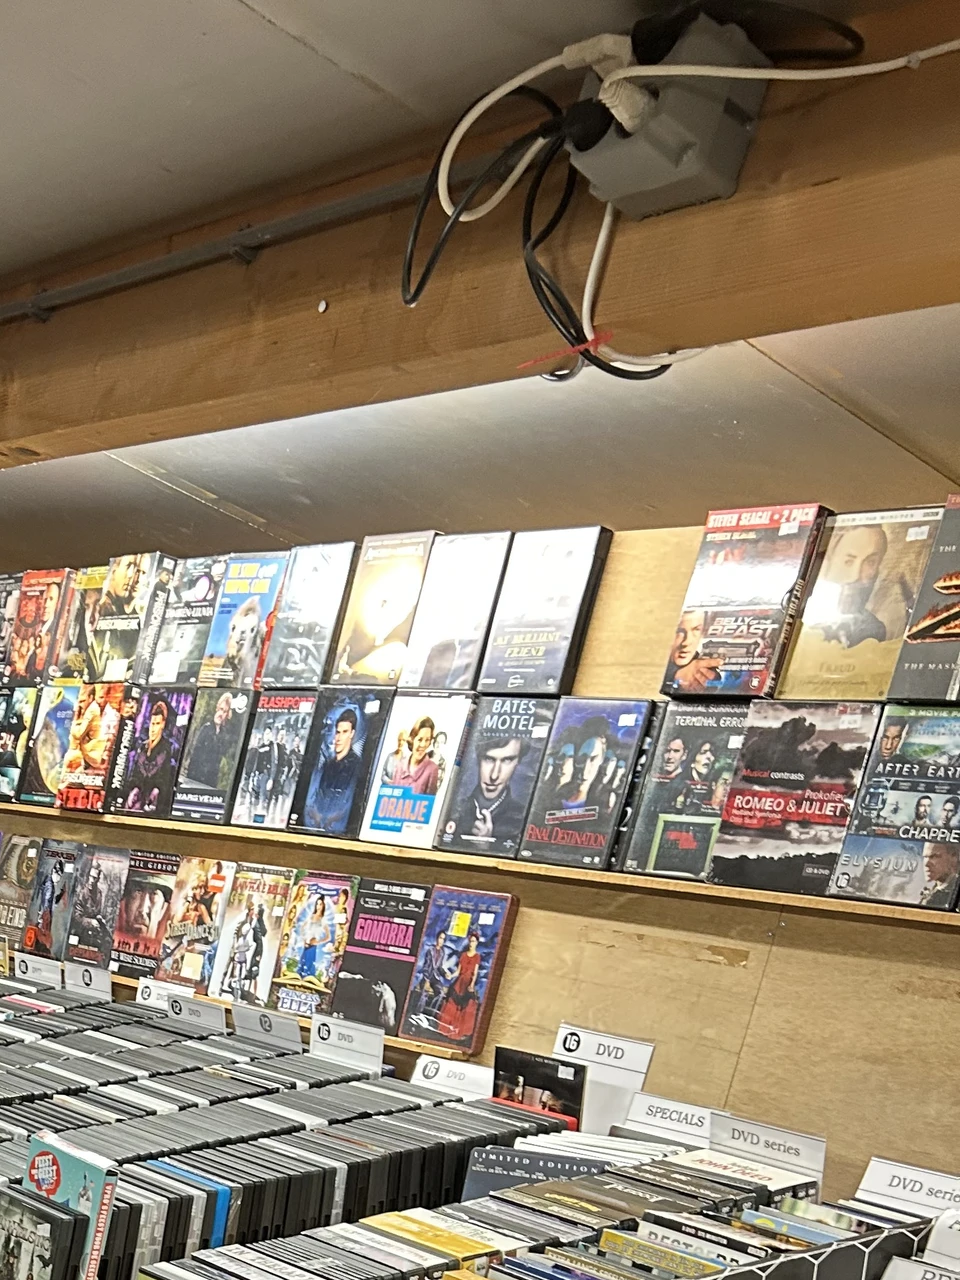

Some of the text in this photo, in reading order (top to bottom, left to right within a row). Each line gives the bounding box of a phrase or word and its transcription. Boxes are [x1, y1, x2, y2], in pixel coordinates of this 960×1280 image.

[708, 513, 739, 528] STEVEN
[739, 511, 772, 525] SEAGAL
[781, 509, 791, 523] 2
[713, 616, 753, 626] BELLY
[708, 625, 778, 637] BEAST
[505, 646, 546, 657] FRIEND
[492, 699, 536, 714] BATES
[709, 705, 750, 714] SURROUN
[483, 715, 535, 731] MOTEL
[675, 716, 718, 728] TERMINAL
[742, 768, 805, 781] Musical contrasts
[875, 762, 960, 779] AFTER EART
[377, 797, 429, 821] ORANJE
[733, 795, 845, 817] ROMEO & JULIET
[526, 824, 608, 849] FINAL DESTINATION
[147, 862, 178, 873] GIBSON
[840, 853, 918, 873] ELYSIUM
[838, 875, 849, 889] 16
[354, 918, 414, 948] GOMORRA
[279, 989, 320, 1002] PRINCESS
[172, 1000, 201, 1018] 12 DVD
[280, 1000, 315, 1015] ELLA
[260, 1015, 271, 1031] 12
[319, 1024, 354, 1043] 16 DVD
[565, 1034, 625, 1060] 16 DVD
[424, 1061, 466, 1081] 16 DVD
[645, 1104, 706, 1128] SPECIALS
[731, 1127, 802, 1157] DVD series
[473, 1150, 530, 1166] LIMITED
[539, 1160, 598, 1174] EDITION
[693, 1157, 731, 1173] JOHN
[731, 1167, 774, 1183] DEED
[888, 1174, 960, 1205] DVD serie
